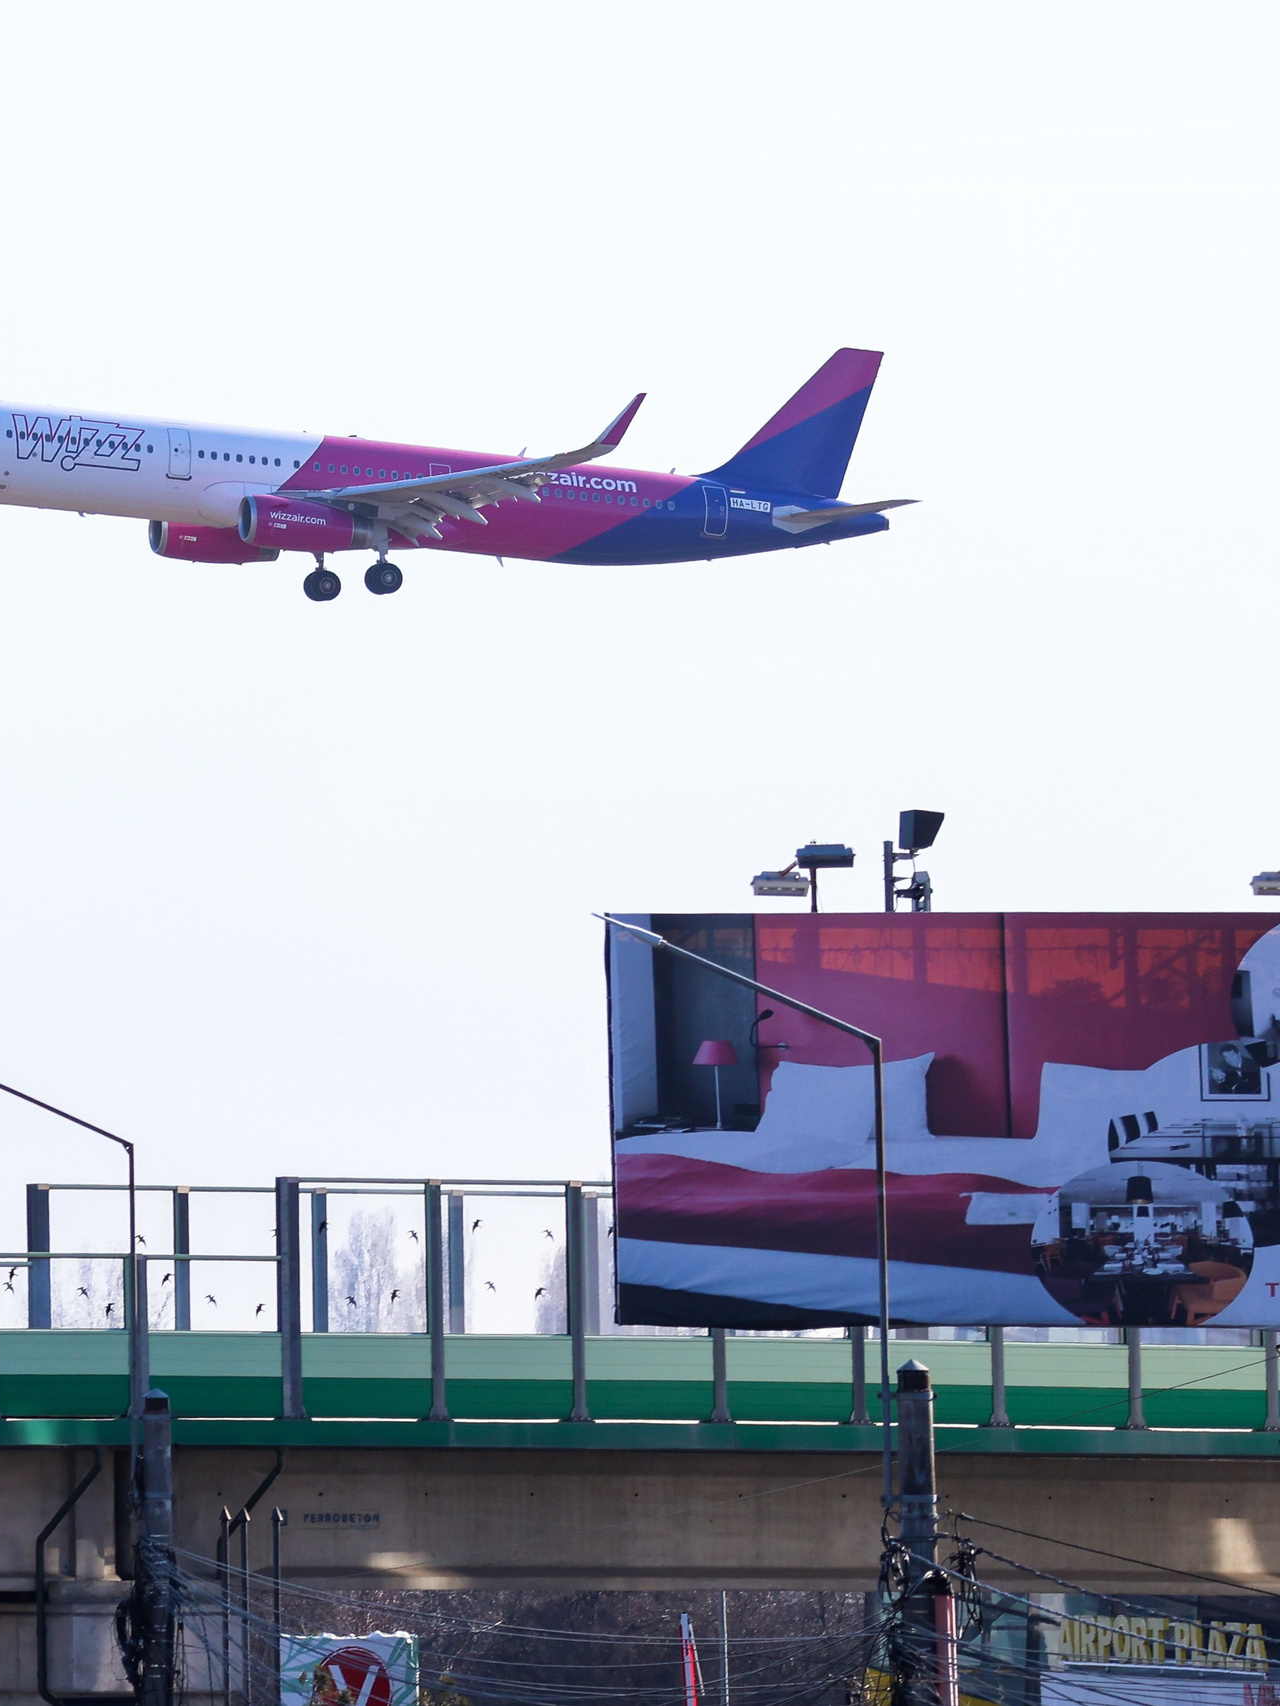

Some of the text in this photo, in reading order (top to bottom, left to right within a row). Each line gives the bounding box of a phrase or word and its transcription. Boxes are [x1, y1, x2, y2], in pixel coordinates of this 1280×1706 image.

[535, 472, 637, 493] zair.com
[732, 498, 769, 511] HA-LTG
[270, 511, 326, 526] wizzair.com
[1058, 1615, 1269, 1674] AIRPORT PLAZA
